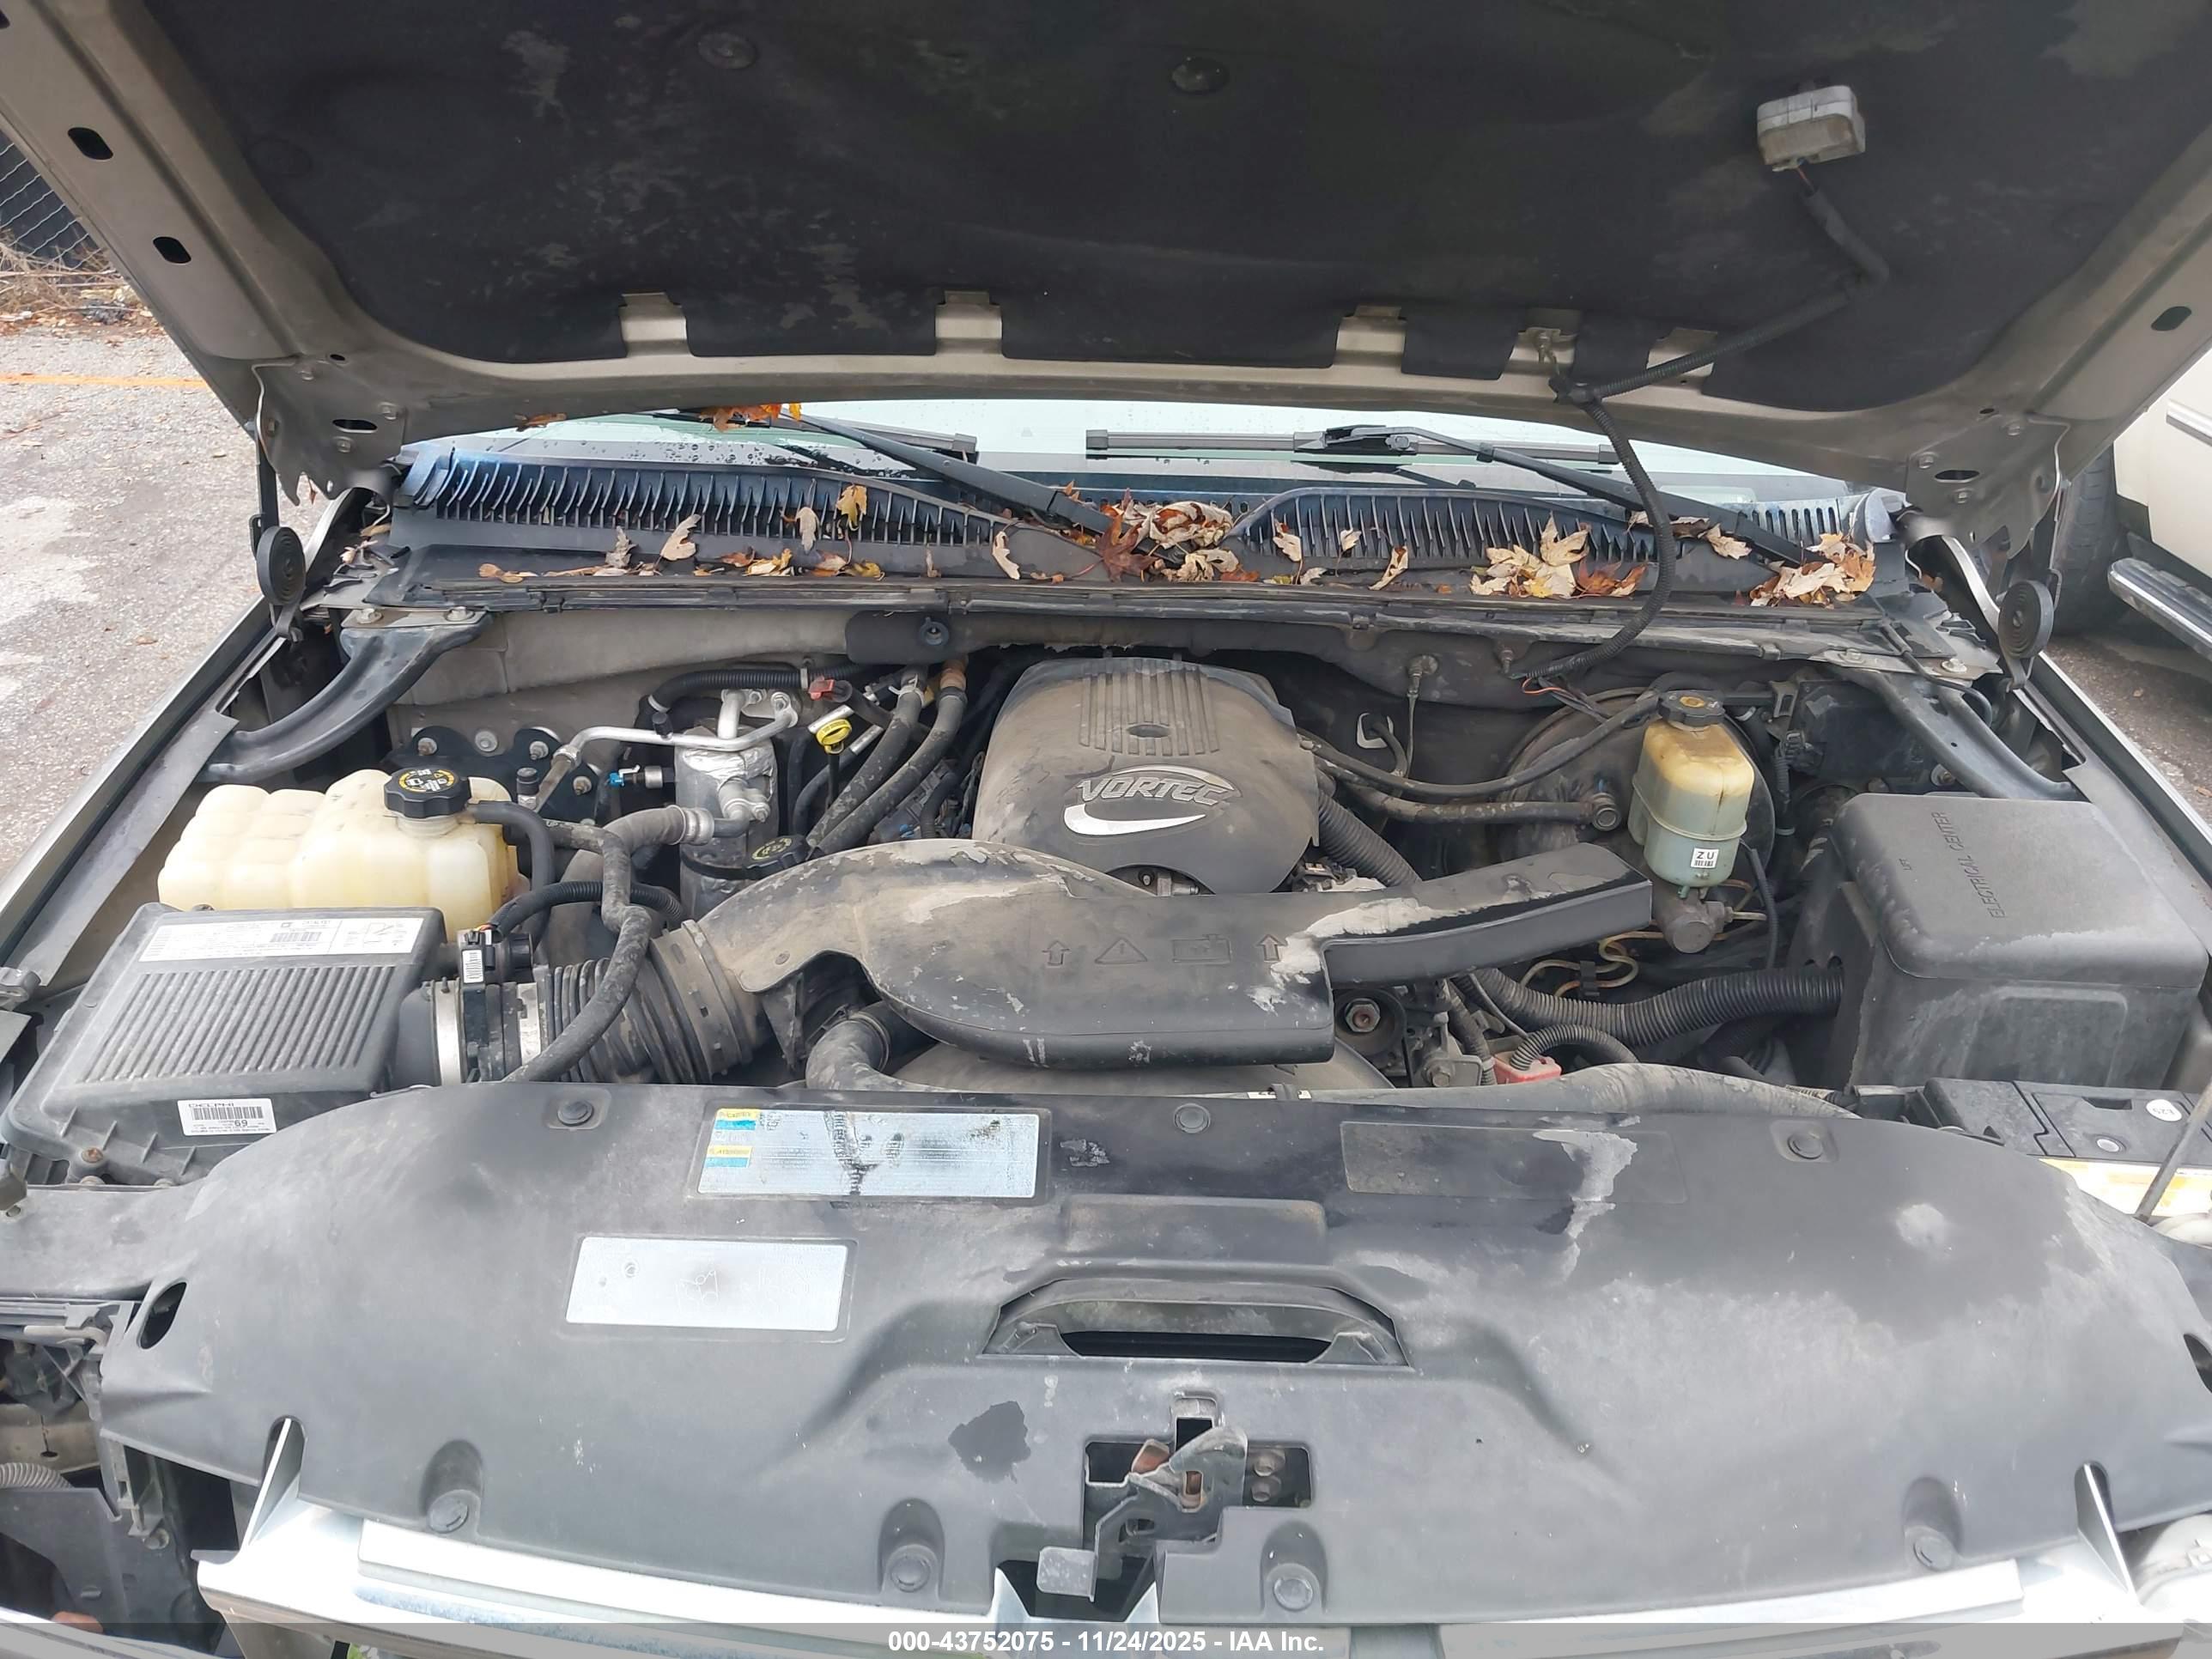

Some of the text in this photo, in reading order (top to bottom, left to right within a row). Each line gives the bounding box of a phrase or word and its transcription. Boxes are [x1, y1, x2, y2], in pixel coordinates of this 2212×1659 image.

[1077, 776, 1229, 806] VORTEC
[1931, 811, 2006, 919] ELECTRICAL CENTER
[234, 1119, 248, 1127] 69
